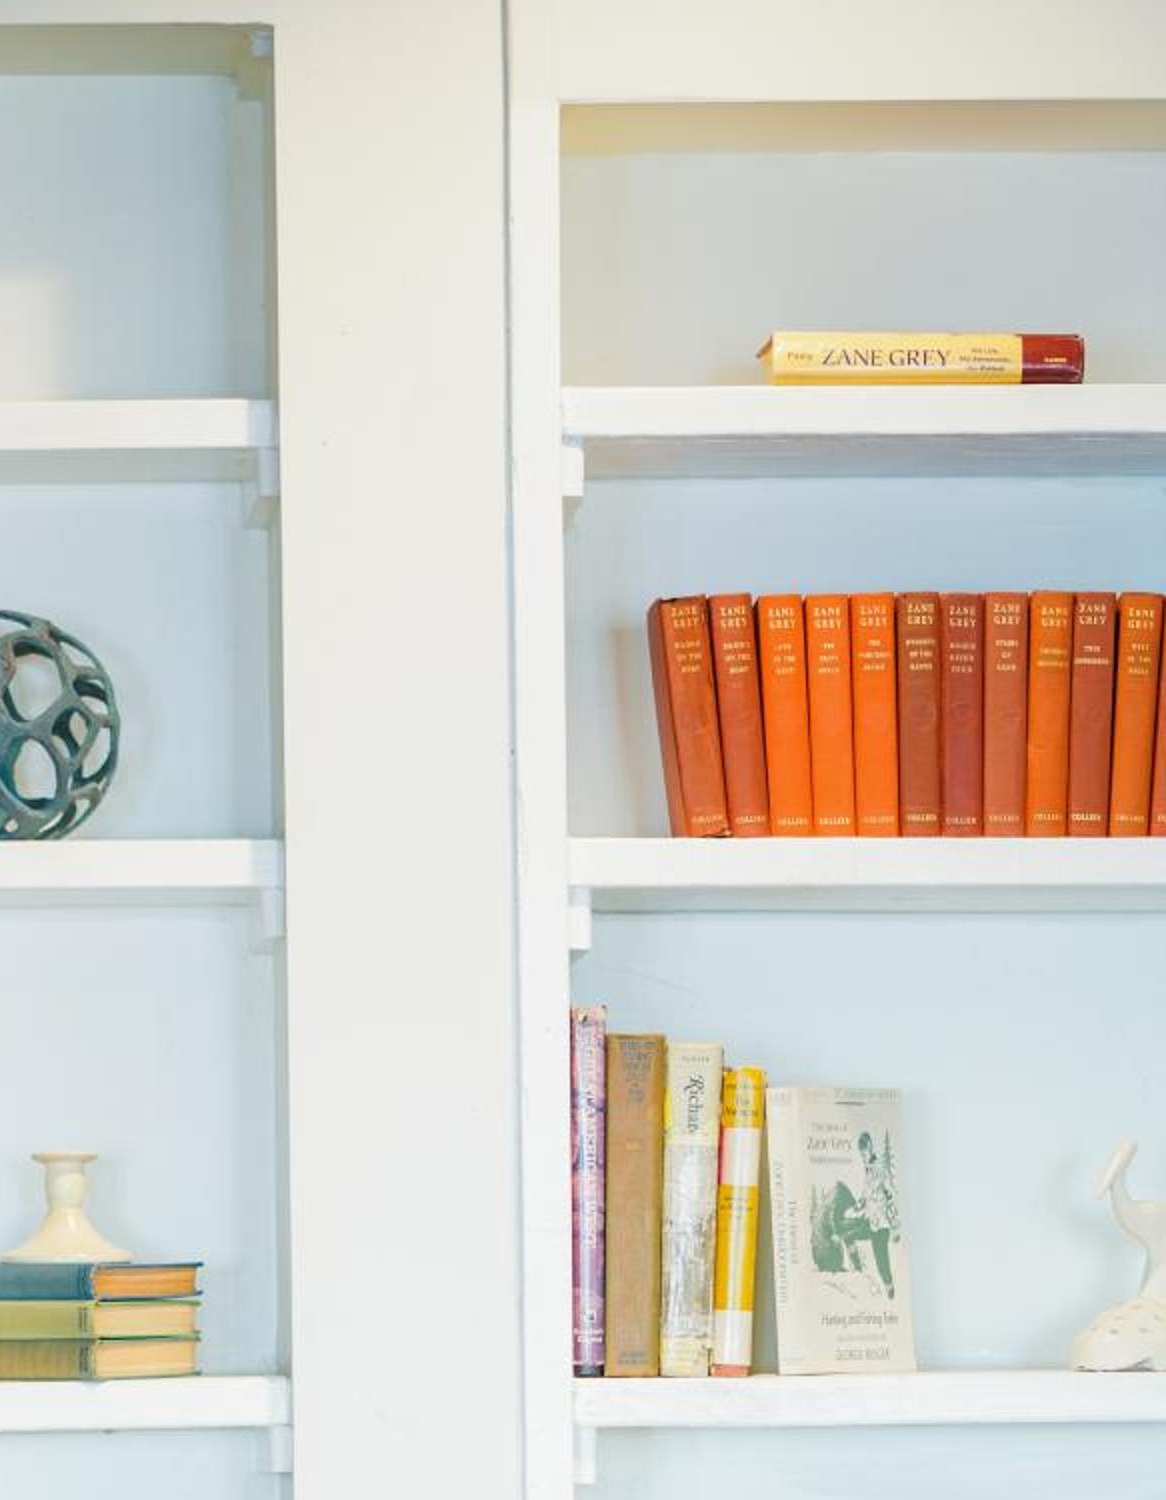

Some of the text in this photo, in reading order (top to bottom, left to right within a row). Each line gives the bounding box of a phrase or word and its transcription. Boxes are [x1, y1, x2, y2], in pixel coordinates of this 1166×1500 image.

[821, 349, 883, 367] ZANE
[889, 349, 950, 367] GREY
[949, 606, 976, 616] ZANE
[994, 603, 1021, 614] ZANE
[1078, 603, 1107, 614] ZANE
[949, 618, 976, 628] GREY
[994, 615, 1020, 625] GREY
[1079, 615, 1106, 625] GREY
